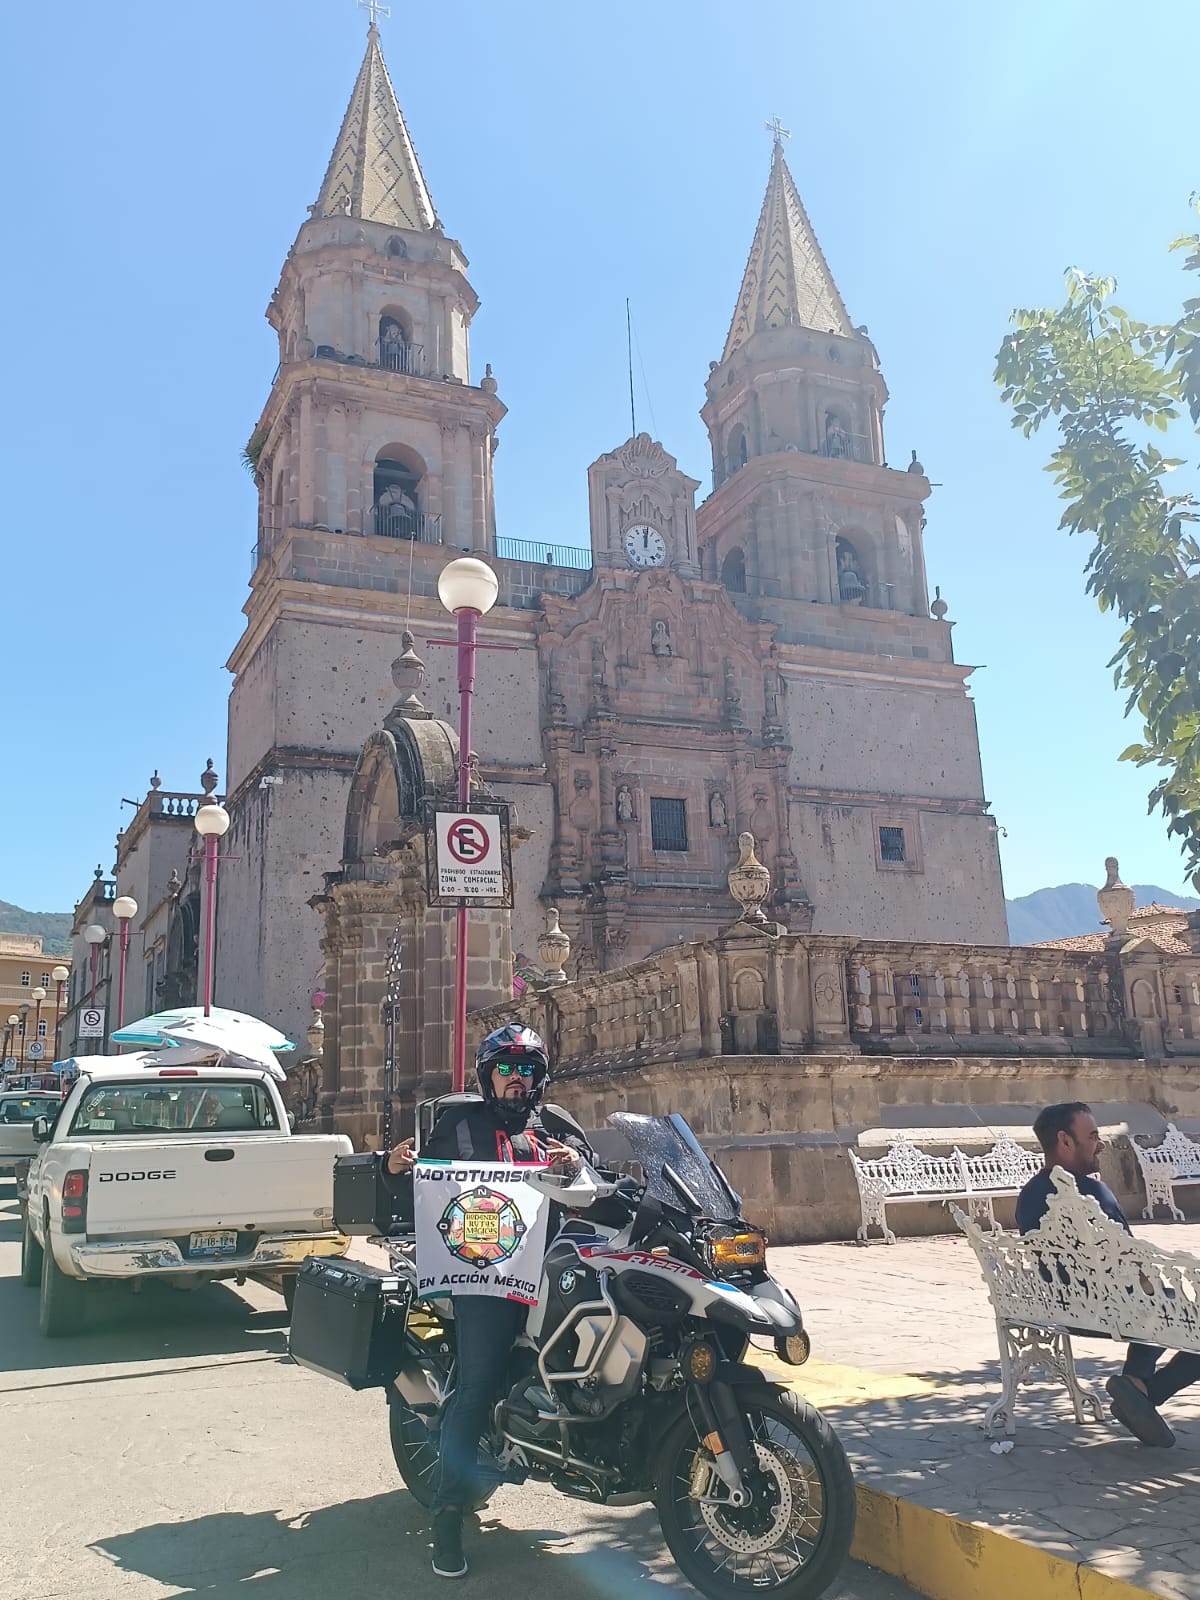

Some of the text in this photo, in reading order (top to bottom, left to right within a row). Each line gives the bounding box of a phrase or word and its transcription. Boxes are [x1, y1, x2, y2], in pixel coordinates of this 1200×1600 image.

[458, 828, 474, 855] E
[440, 875, 457, 883] ZONA
[99, 1170, 177, 1182] DODGE
[415, 1168, 525, 1183] MOTOTURIS
[477, 1188, 487, 1196] N
[419, 1271, 536, 1294] EN ACCIÓN MÉXICO
